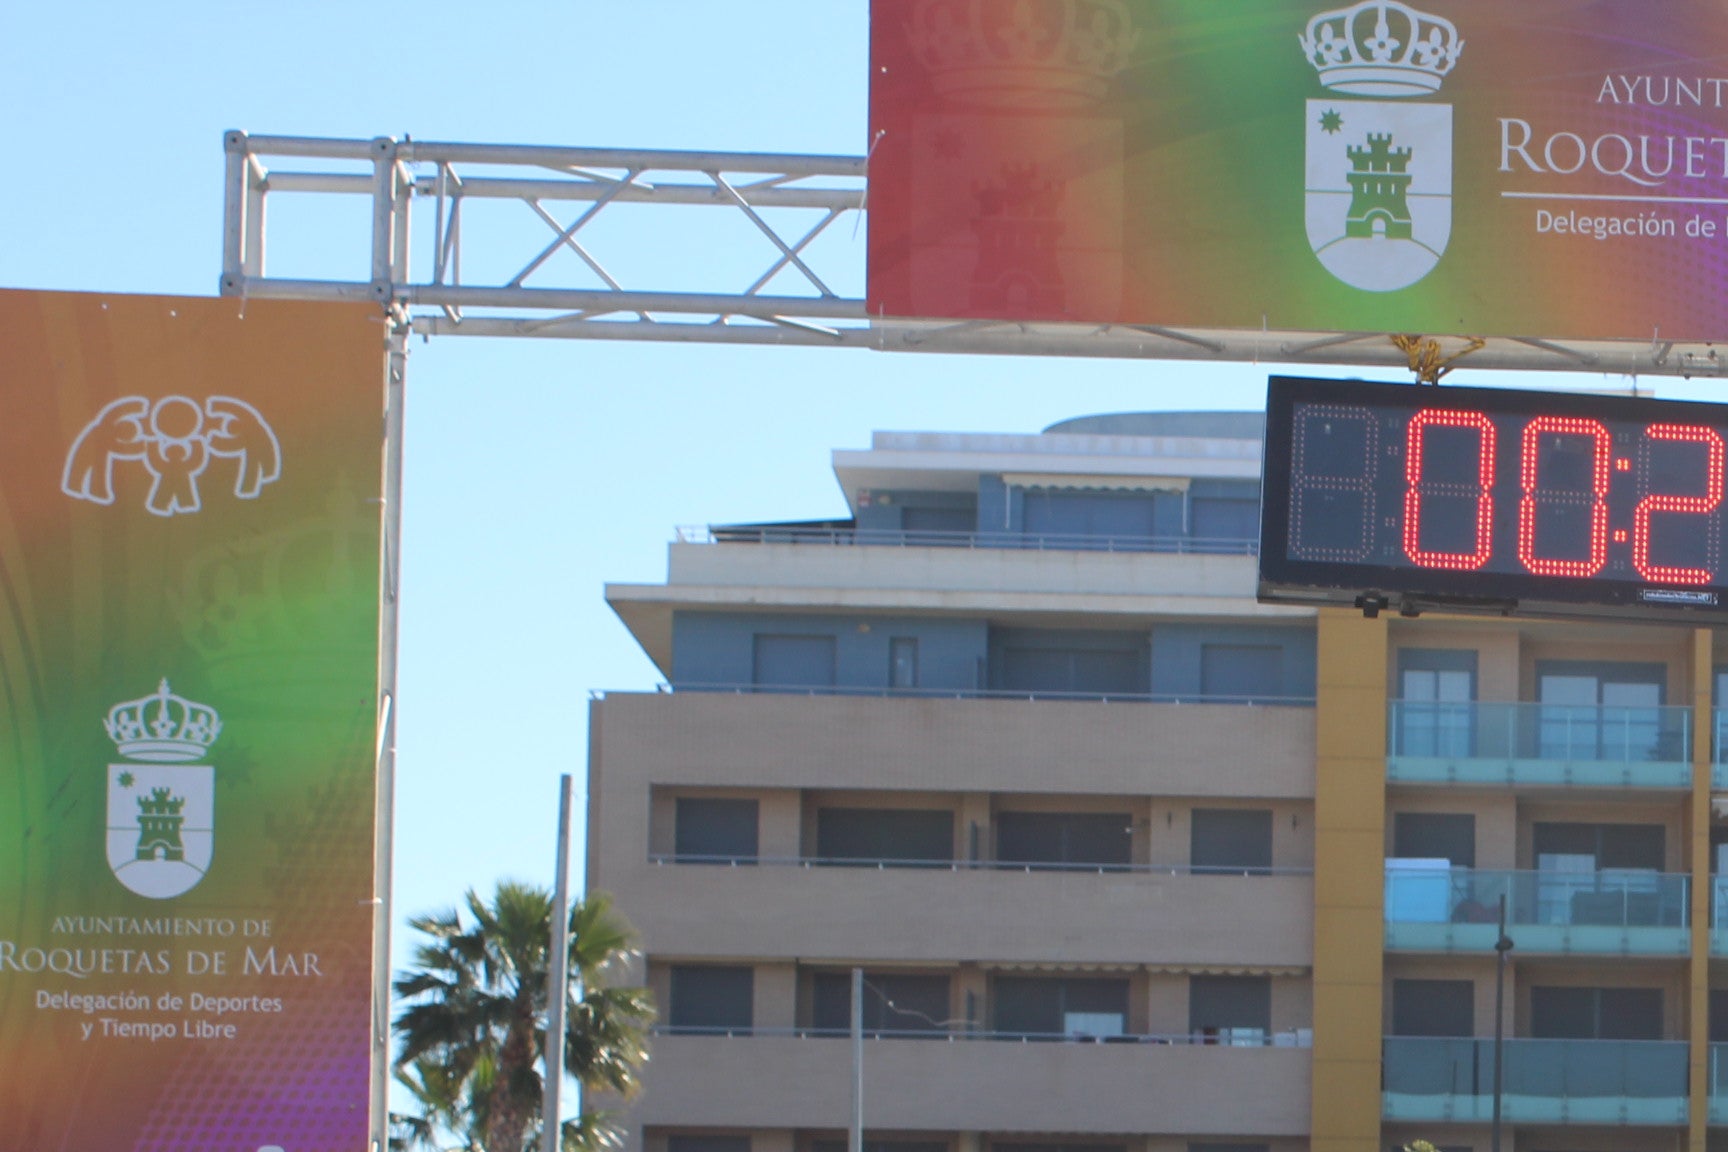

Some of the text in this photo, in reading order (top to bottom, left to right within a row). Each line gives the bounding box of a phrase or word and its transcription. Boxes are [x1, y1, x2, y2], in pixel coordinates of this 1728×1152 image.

[1536, 209, 1676, 239] Delegación
[1684, 214, 1717, 238] de
[51, 916, 272, 938] AYUNTAMIENTO DE
[186, 951, 226, 976] DE
[242, 946, 323, 977] MAR
[36, 989, 283, 1018] Delegación de Deportes
[81, 1018, 237, 1043] y Tiempo Libre
